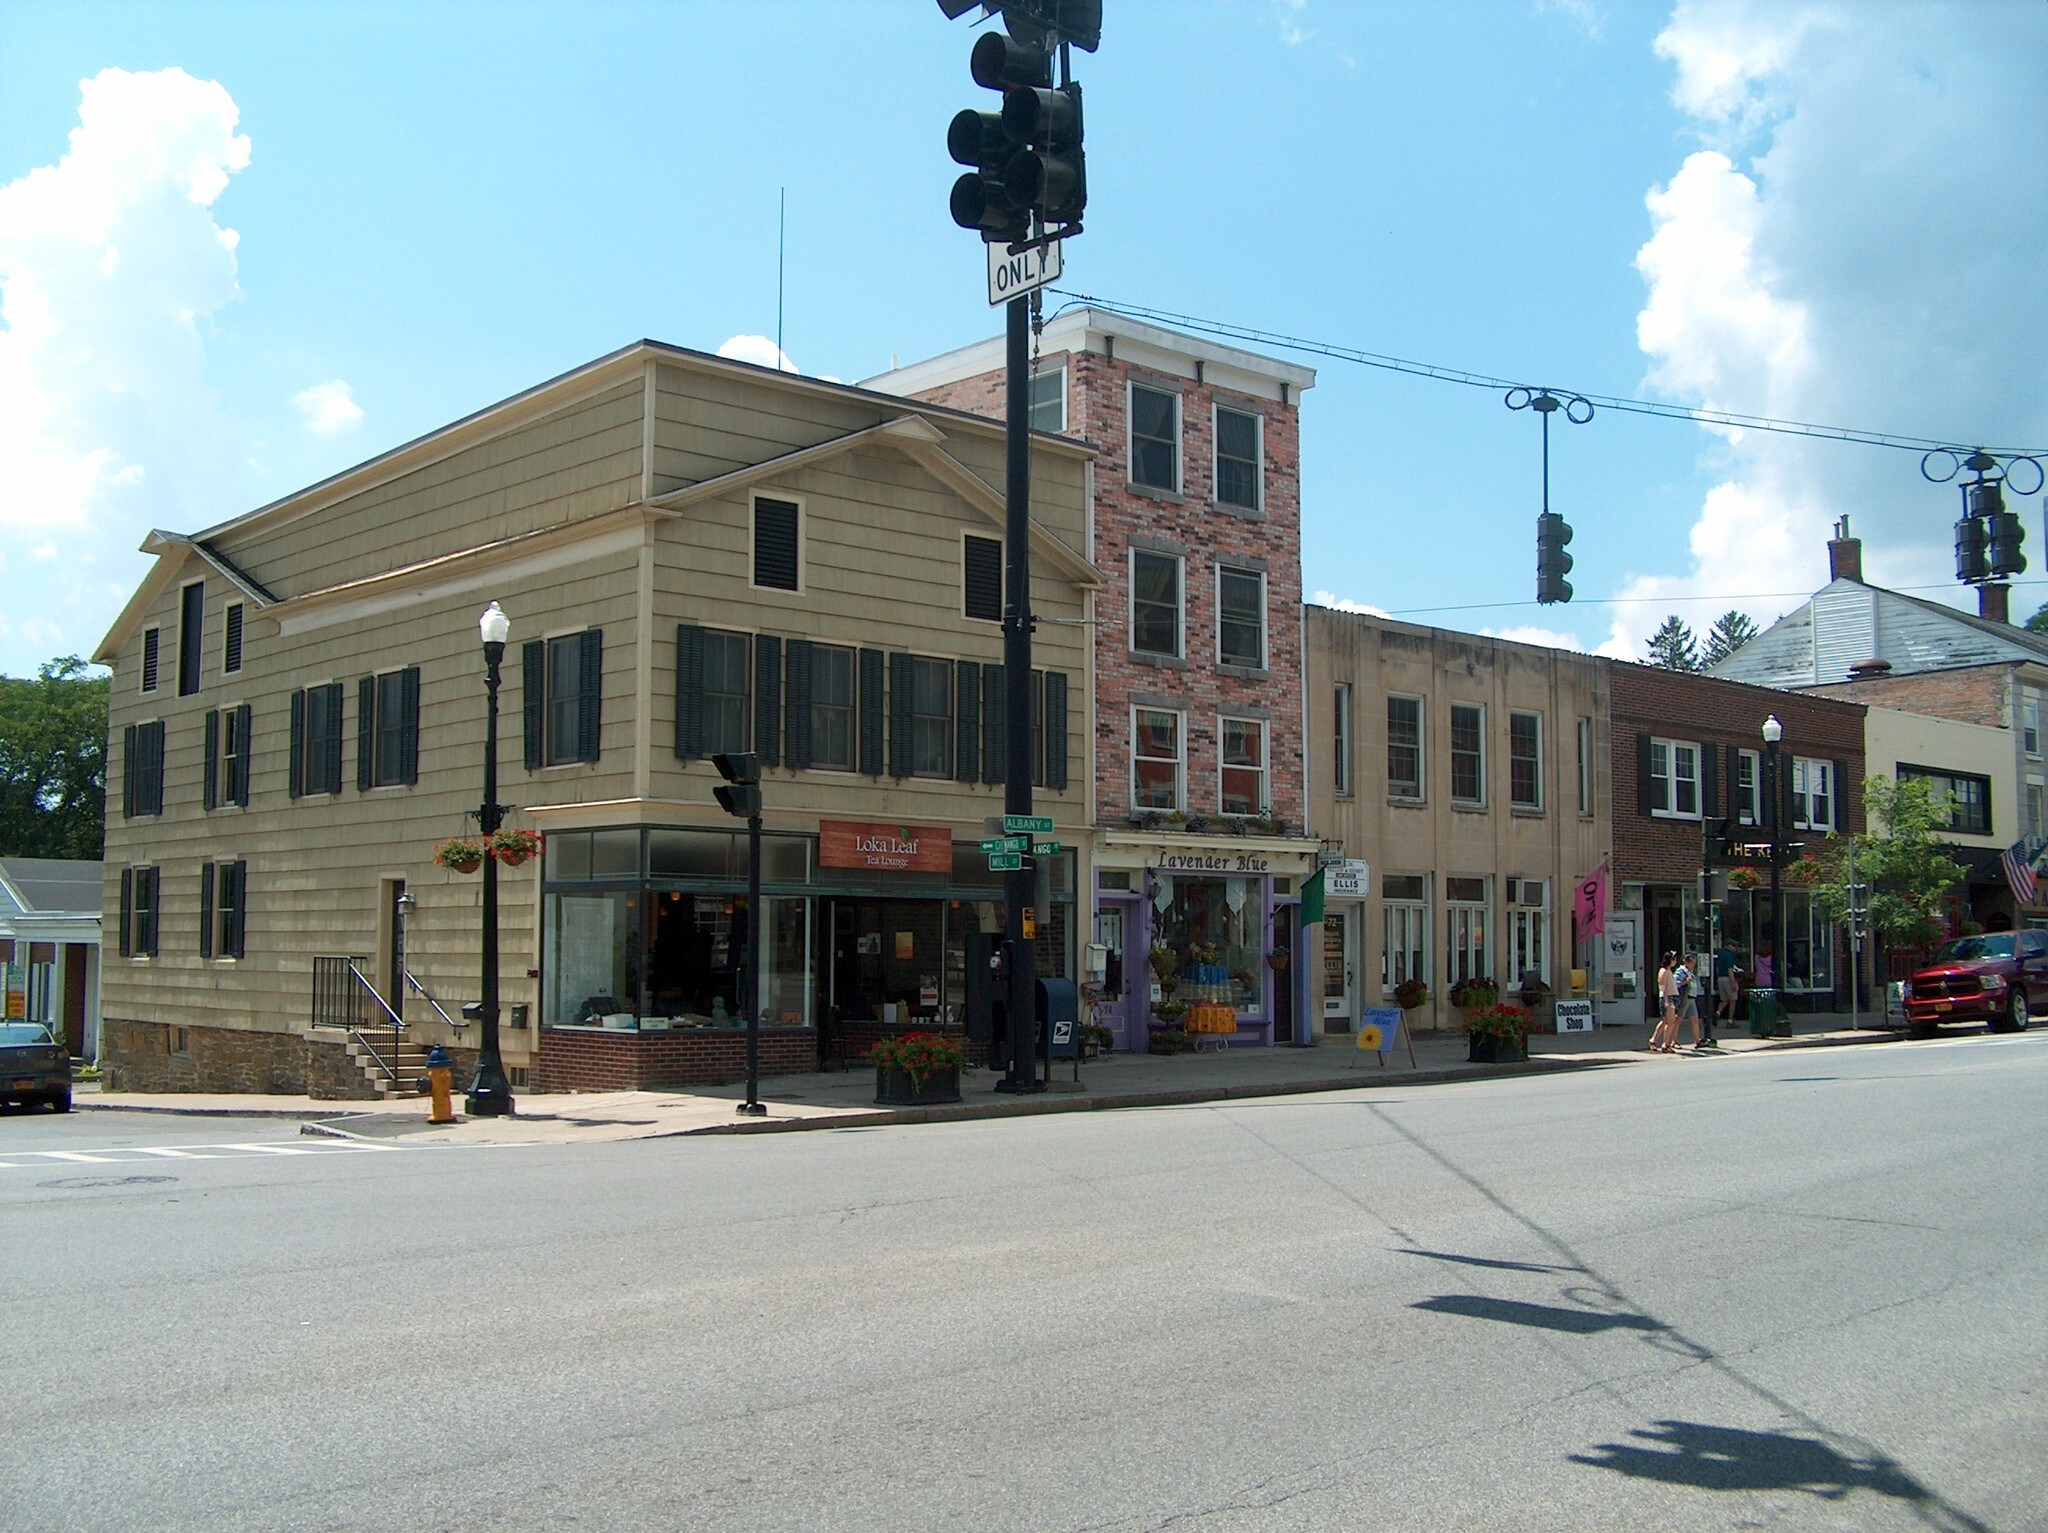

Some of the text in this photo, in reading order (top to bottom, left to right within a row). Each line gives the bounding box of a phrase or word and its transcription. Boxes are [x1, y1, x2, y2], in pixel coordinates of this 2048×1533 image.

[997, 249, 1049, 292] ONLY
[1006, 820, 1042, 830] ALBANY
[856, 835, 919, 855] Loka Leaf
[866, 854, 909, 868] Tea Lounge
[992, 857, 1009, 867] MILL
[1157, 851, 1268, 871] Lavender Blue
[1333, 879, 1359, 888] ELLIS
[1327, 917, 1337, 927] 72
[1103, 1005, 1112, 1015] 74
[1557, 1003, 1590, 1017] Chocolate
[1566, 1017, 1584, 1030] Shop
